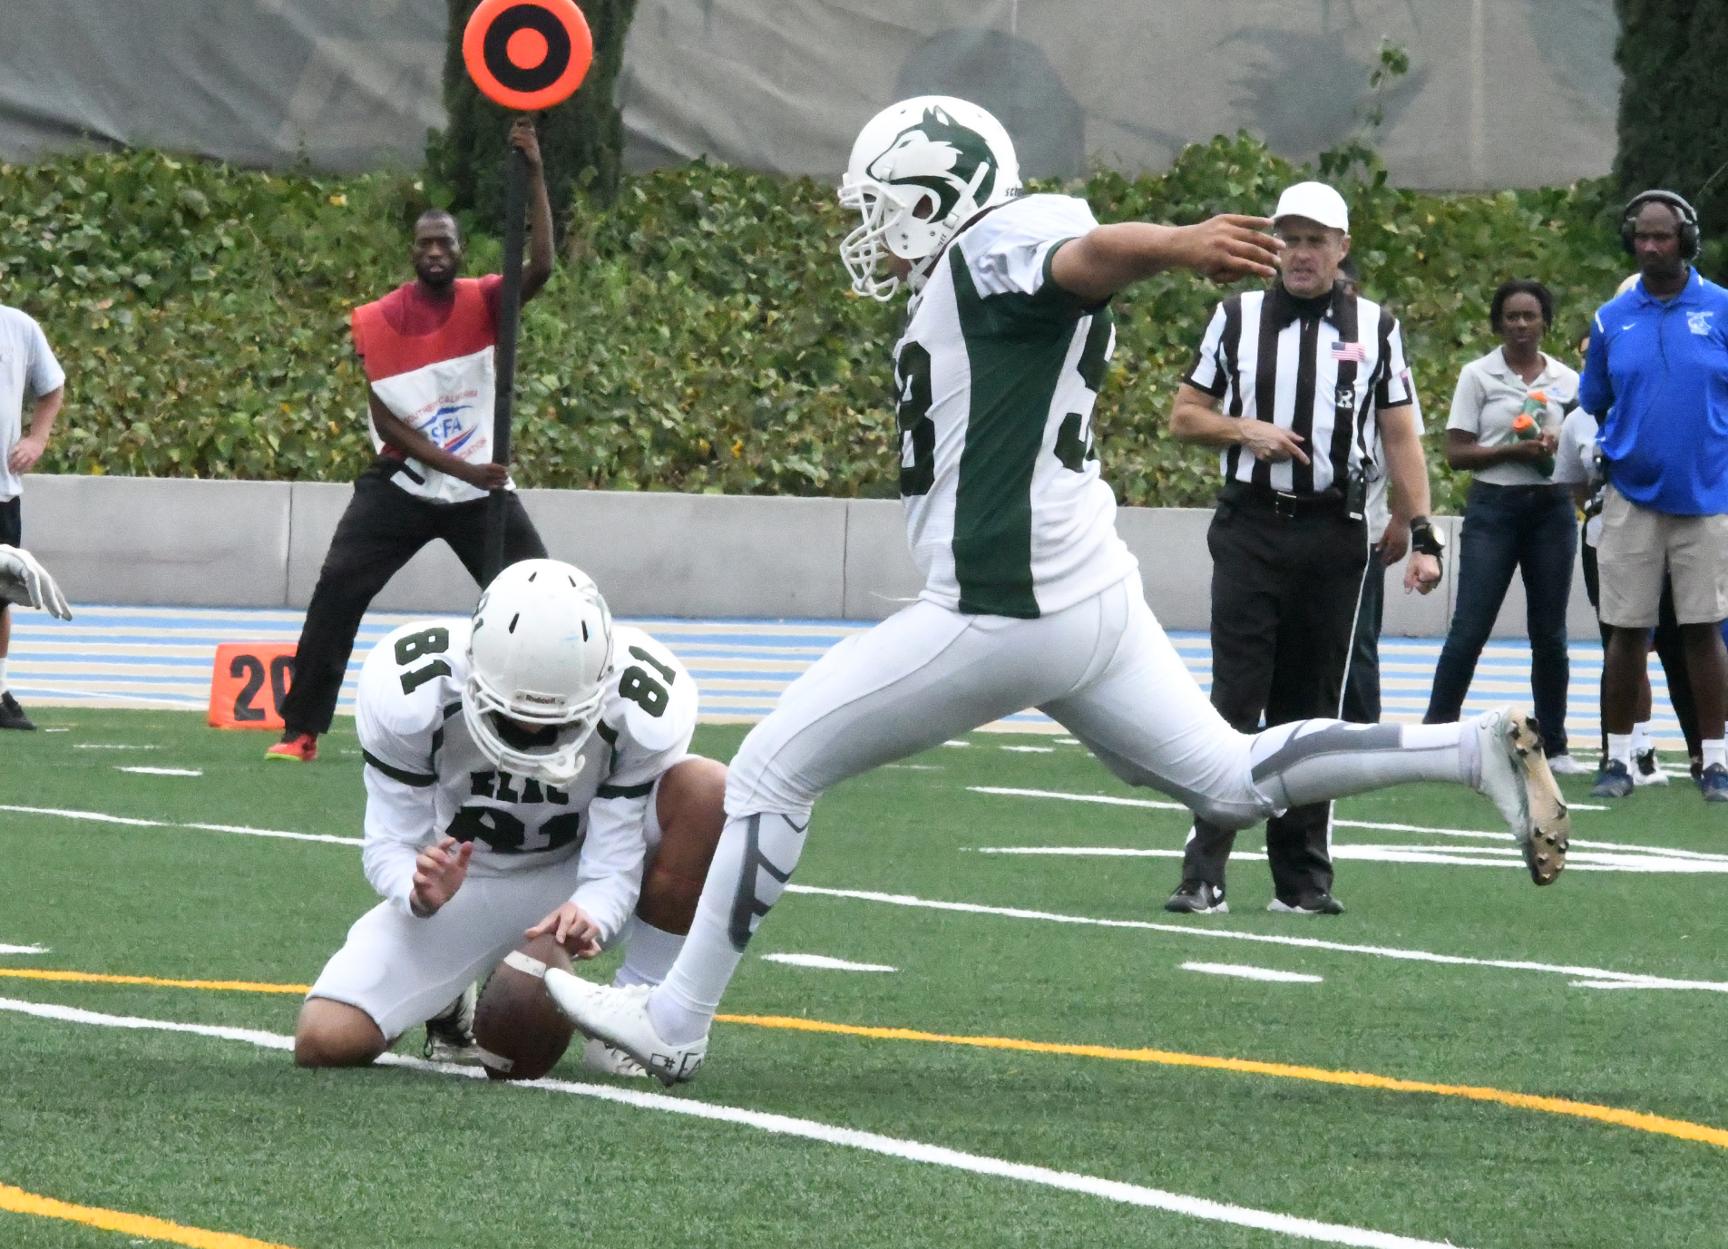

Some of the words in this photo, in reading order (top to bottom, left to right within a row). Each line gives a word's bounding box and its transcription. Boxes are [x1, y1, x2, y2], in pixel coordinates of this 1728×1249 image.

[229, 654, 297, 720] 20
[394, 627, 452, 695] 81
[619, 645, 676, 717] 81
